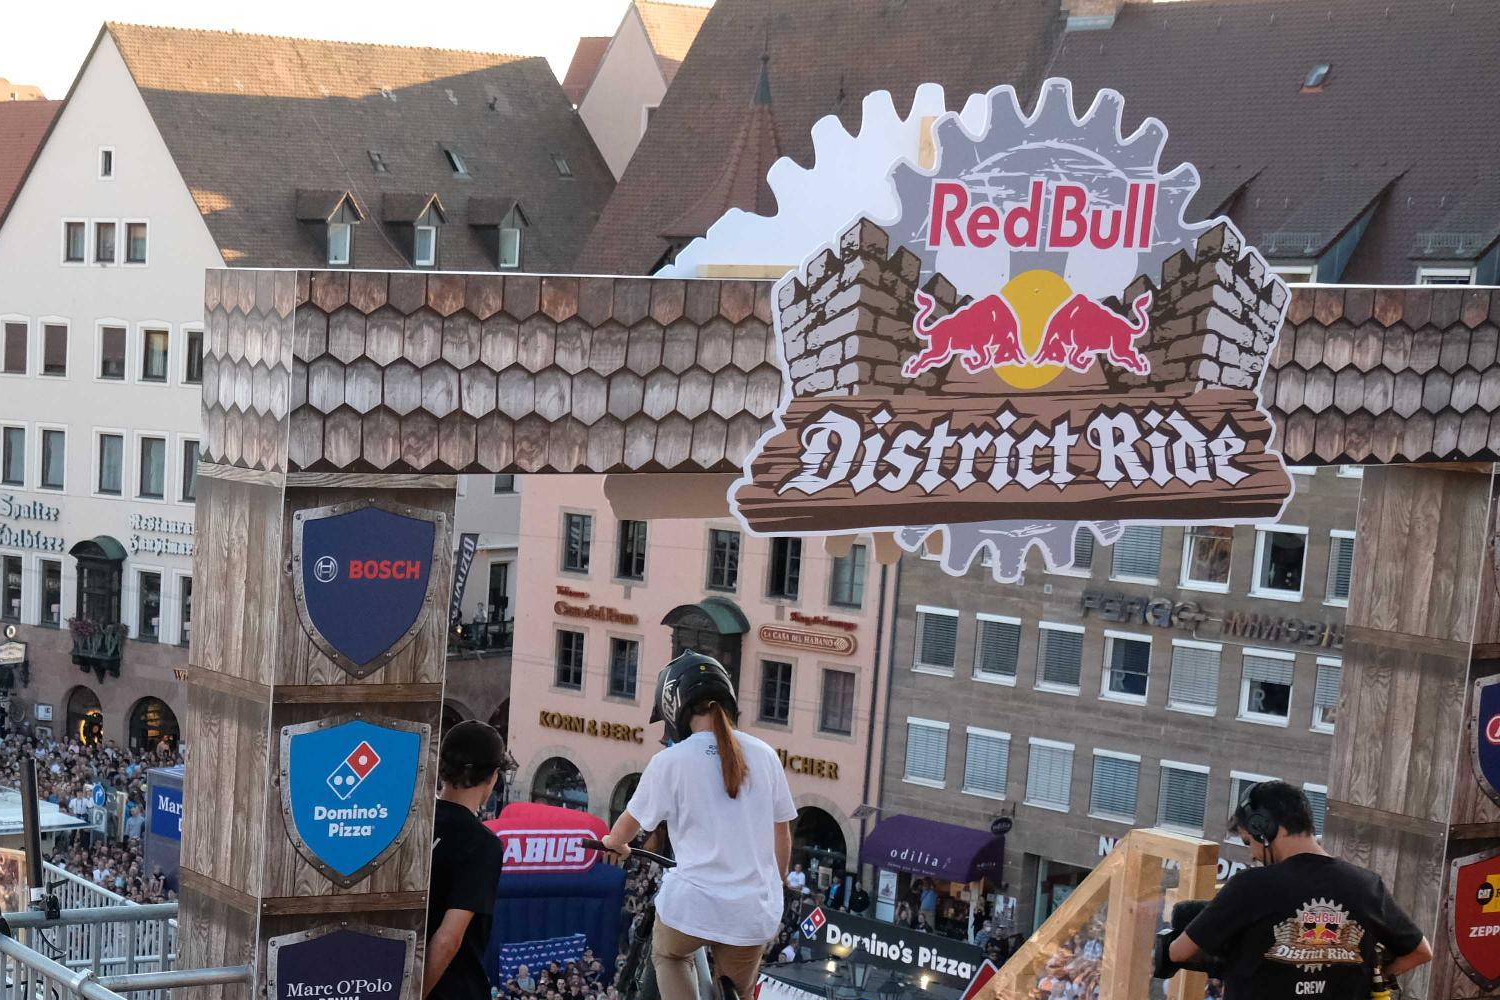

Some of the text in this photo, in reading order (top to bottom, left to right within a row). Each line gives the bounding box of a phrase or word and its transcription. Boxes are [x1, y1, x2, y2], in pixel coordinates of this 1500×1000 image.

[928, 181, 1155, 249] Red Bull
[778, 408, 1252, 495] District Ride
[0, 494, 60, 521] Spalter
[348, 560, 421, 580] BOSCH
[772, 632, 790, 641] CASA
[804, 636, 834, 647] HABANO
[539, 710, 585, 734] KORN
[587, 719, 598, 737] &
[314, 803, 388, 821] Domino's
[328, 822, 372, 837] Pizza
[502, 837, 585, 863] ABUS
[890, 848, 939, 867] odilia
[1477, 887, 1491, 899] CAT
[1302, 911, 1342, 923] Red Bull
[1469, 924, 1500, 938] ZEPP
[826, 923, 971, 979] Domino's Pizza
[1275, 944, 1356, 960] District Ride
[286, 978, 393, 997] Marc O'Polo
[1295, 980, 1326, 995] CREW
